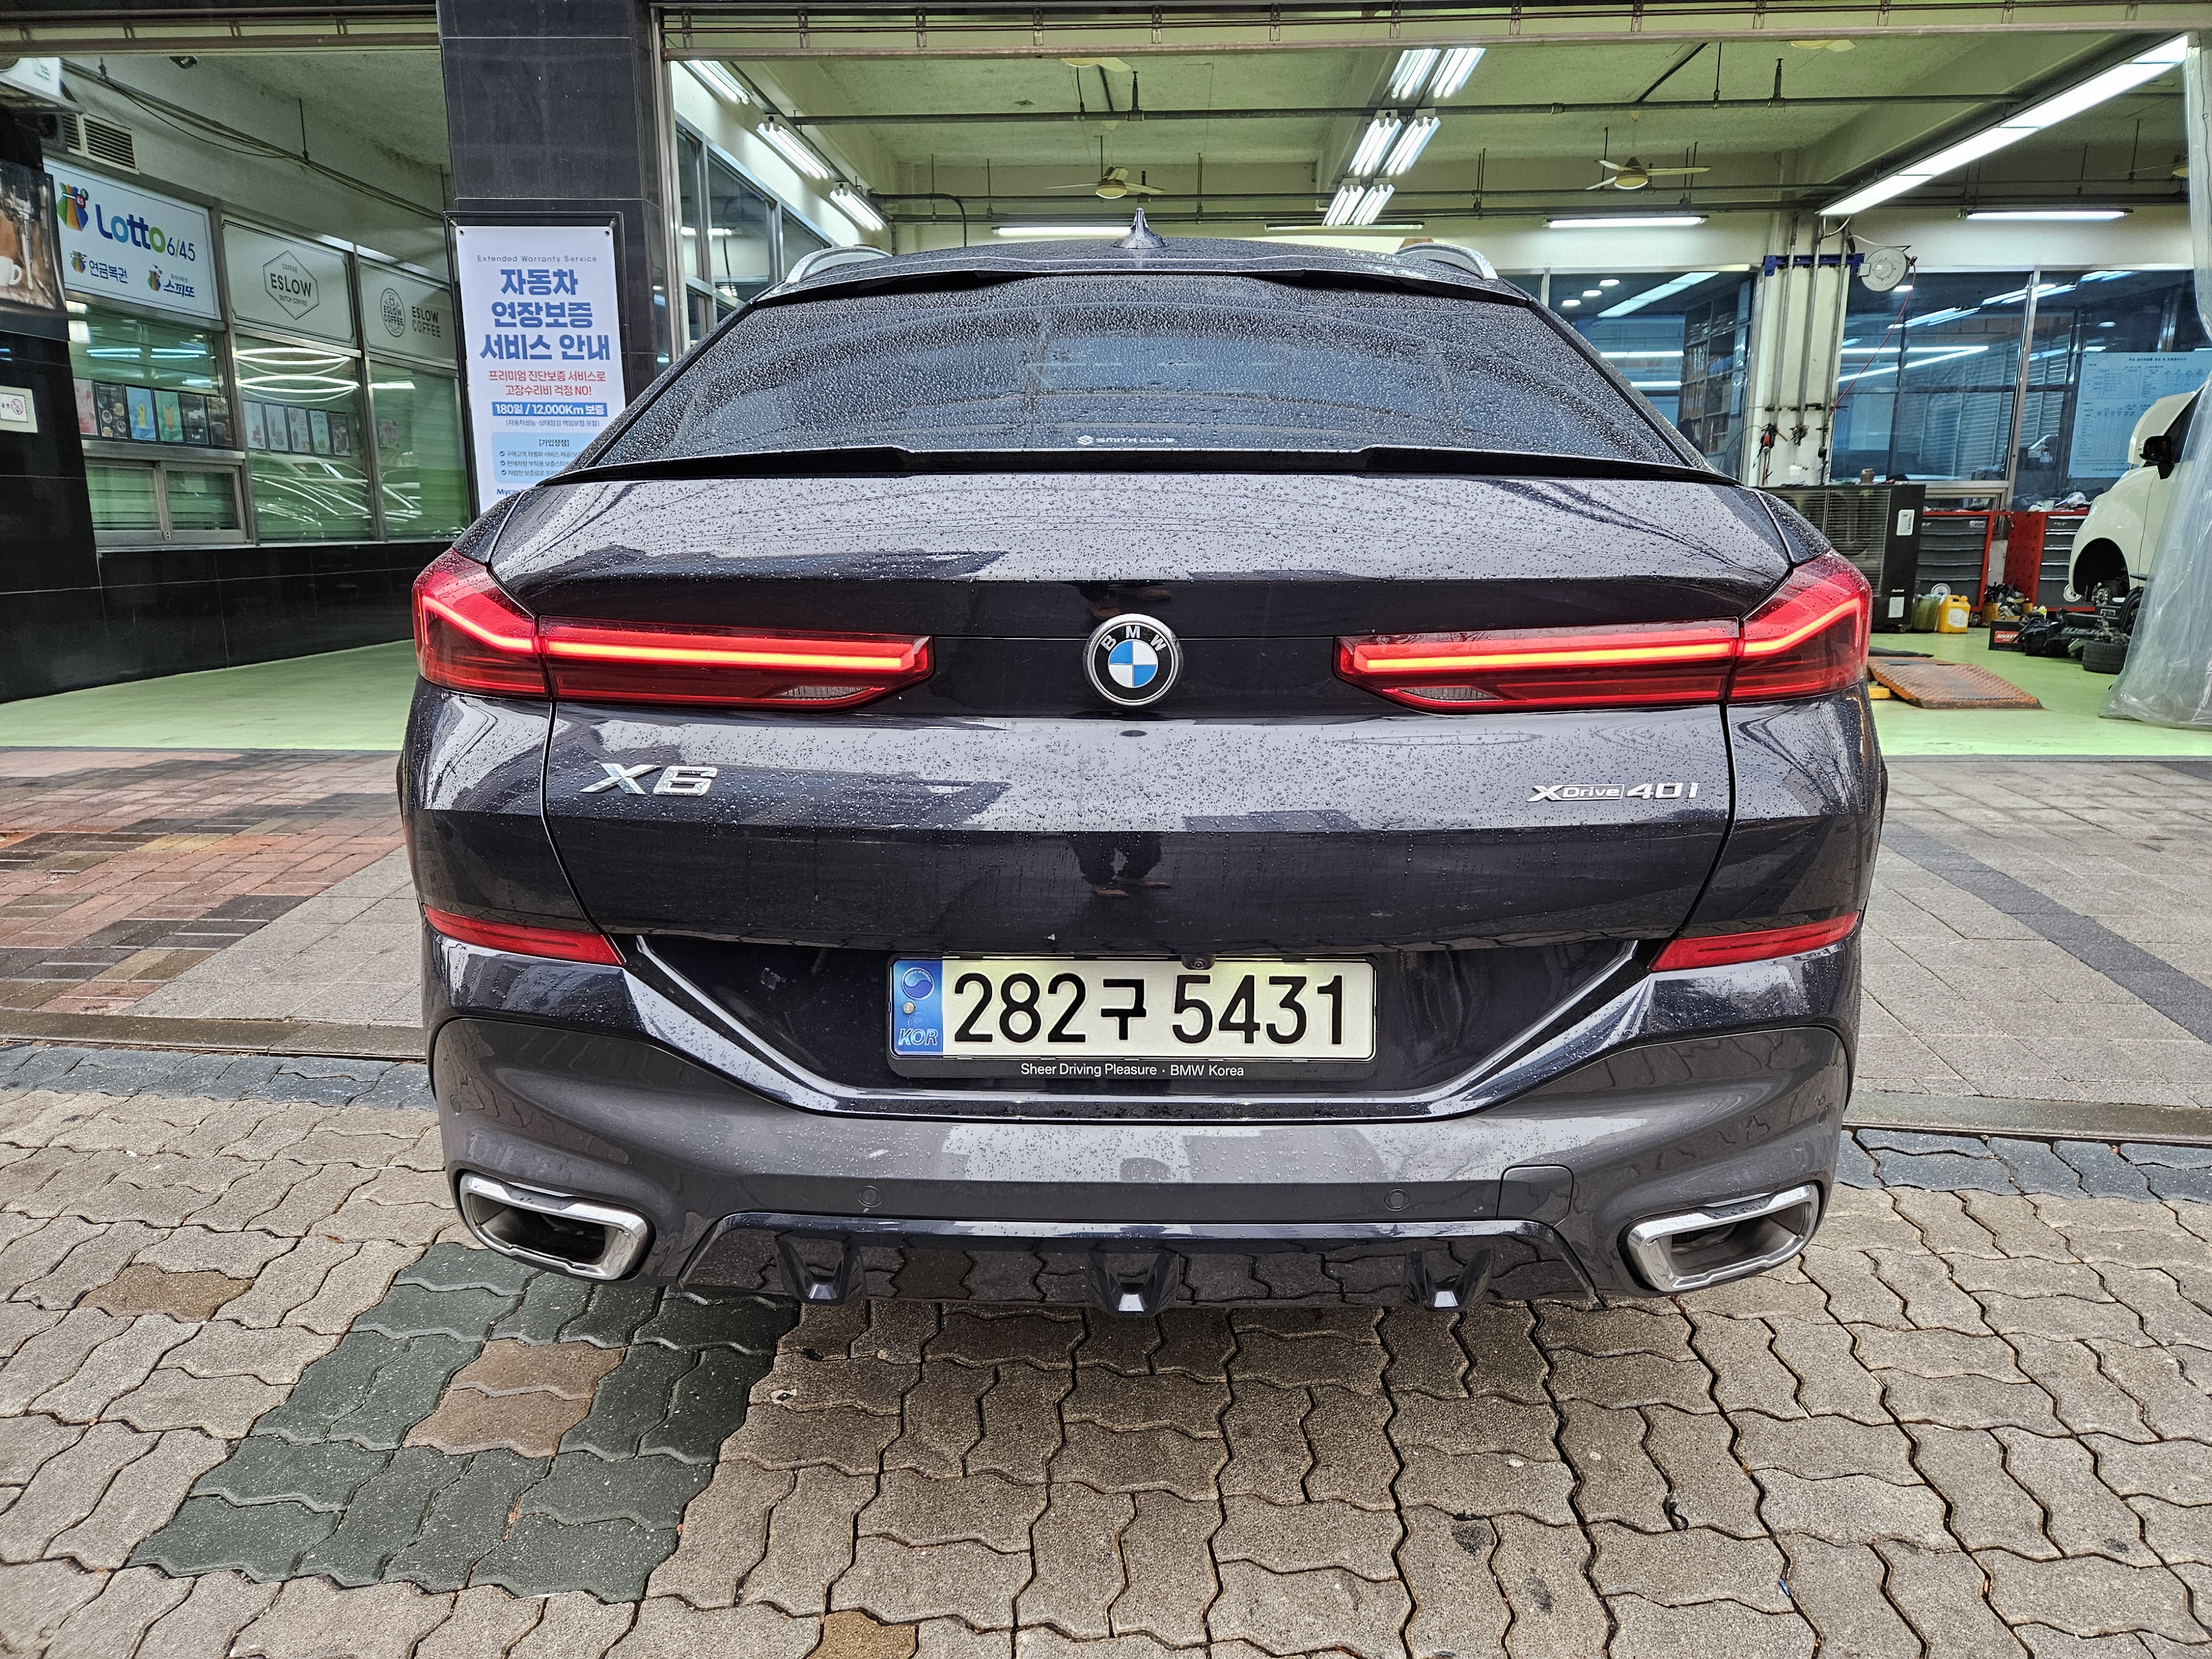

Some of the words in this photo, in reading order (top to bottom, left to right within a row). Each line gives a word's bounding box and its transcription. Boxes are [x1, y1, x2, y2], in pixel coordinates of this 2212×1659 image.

[95, 204, 166, 253] Lotto
[167, 237, 196, 262] 6/45
[282, 263, 298, 273] COFFEE
[521, 255, 561, 263] Warranty
[89, 259, 128, 284] 연금복권
[163, 279, 196, 298] 스피또
[270, 273, 311, 298] ESLOW
[500, 269, 578, 295] 자동차
[293, 298, 308, 307] COFFEE
[411, 306, 439, 324] ESLOW
[491, 301, 593, 328] 연장보증
[411, 320, 441, 338] COFFEE
[479, 334, 552, 360] 서비스
[559, 334, 611, 361] 안내
[488, 370, 526, 382] 프리미엄
[528, 371, 566, 382] 진단보증
[568, 371, 606, 382] 서비스로
[505, 385, 552, 396] 고장수리비
[554, 385, 573, 397] 걱정
[575, 385, 592, 395] NO!
[494, 404, 524, 415] 180일
[531, 404, 584, 416] 12,000Km
[585, 404, 605, 415] 보증
[539, 439, 570, 447] [가입장점]
[1100, 625, 1167, 651] BMW
[579, 763, 718, 797] X6
[953, 972, 1146, 1043] 282구
[1172, 974, 1344, 1045] 5431
[898, 1028, 938, 1046] KOR
[1020, 1062, 1057, 1075] Sheer
[1059, 1063, 1102, 1077] Driving
[1105, 1063, 1157, 1076] Pleasure
[1170, 1065, 1205, 1076] BMW
[1208, 1065, 1245, 1076] Korea
